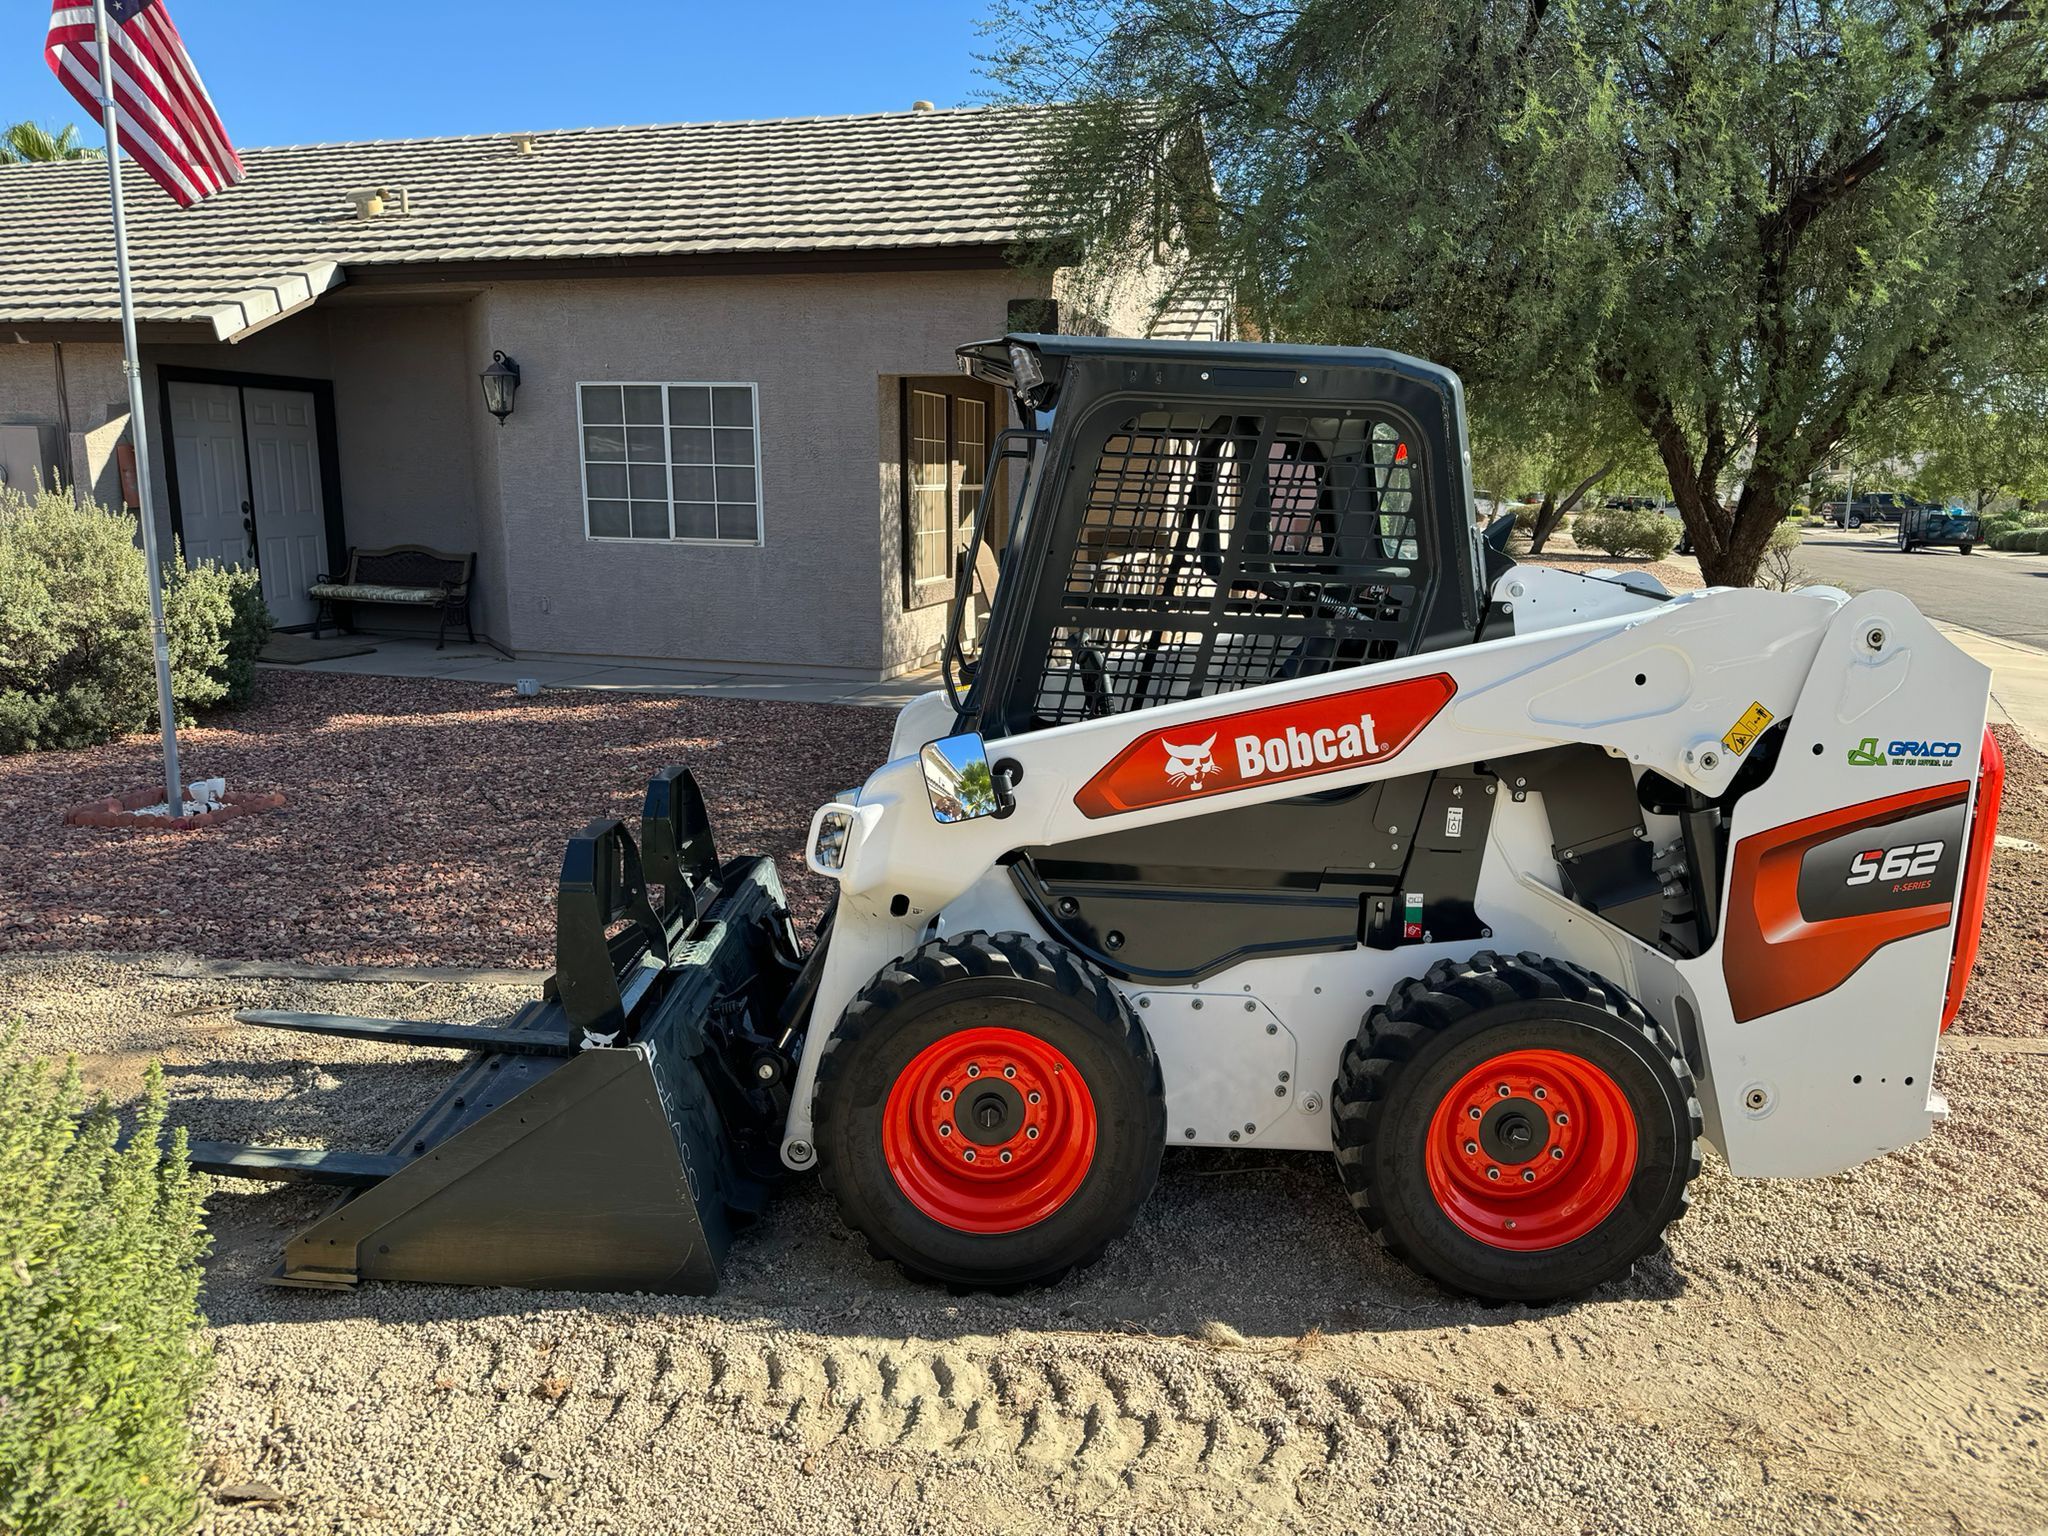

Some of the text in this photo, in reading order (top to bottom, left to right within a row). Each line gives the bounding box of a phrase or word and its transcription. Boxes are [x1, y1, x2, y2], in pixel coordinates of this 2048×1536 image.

[1234, 713, 1380, 779] Bobcat
[1887, 740, 1962, 757] GRACO
[1846, 840, 1945, 886] S62
[1892, 880, 1932, 893] R-SERIES
[654, 1063, 701, 1202] GRACO
